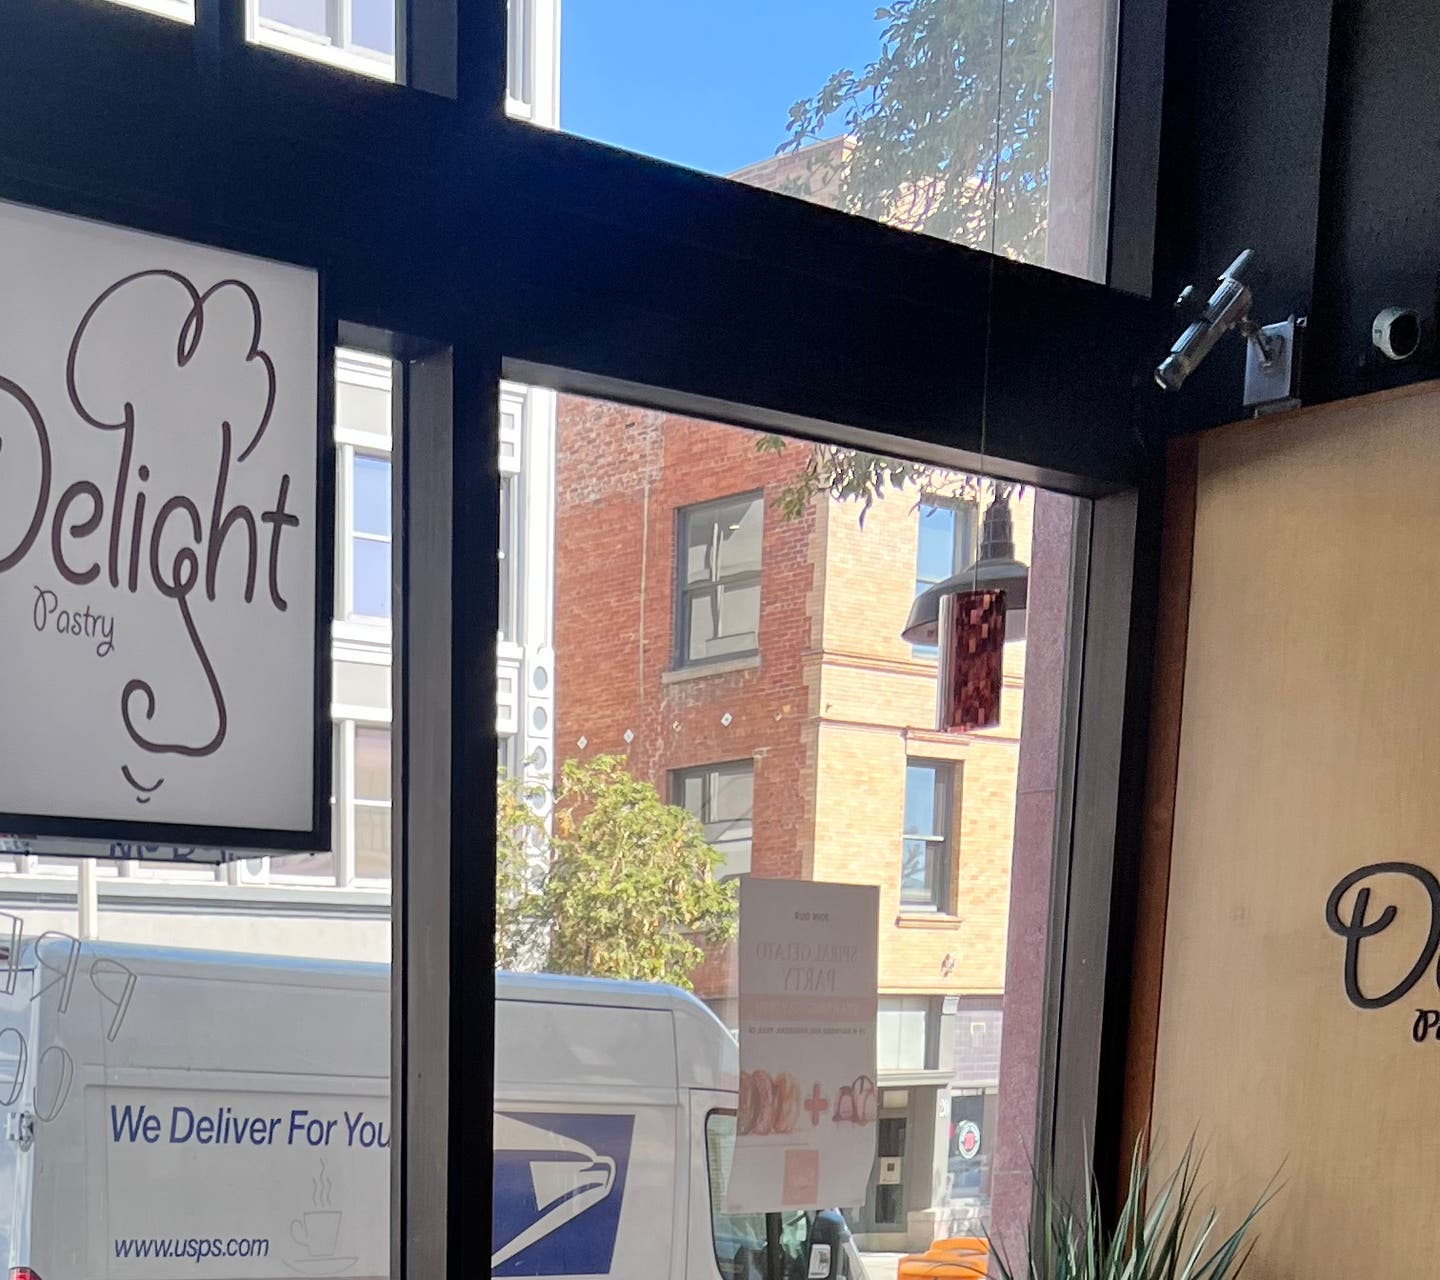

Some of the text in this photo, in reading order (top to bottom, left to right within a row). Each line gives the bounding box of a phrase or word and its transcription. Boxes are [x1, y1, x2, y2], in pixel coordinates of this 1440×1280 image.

[33, 585, 115, 657] Pastry
[110, 1104, 391, 1148] We Deliver For You
[114, 1237, 270, 1263] www.usps.com
